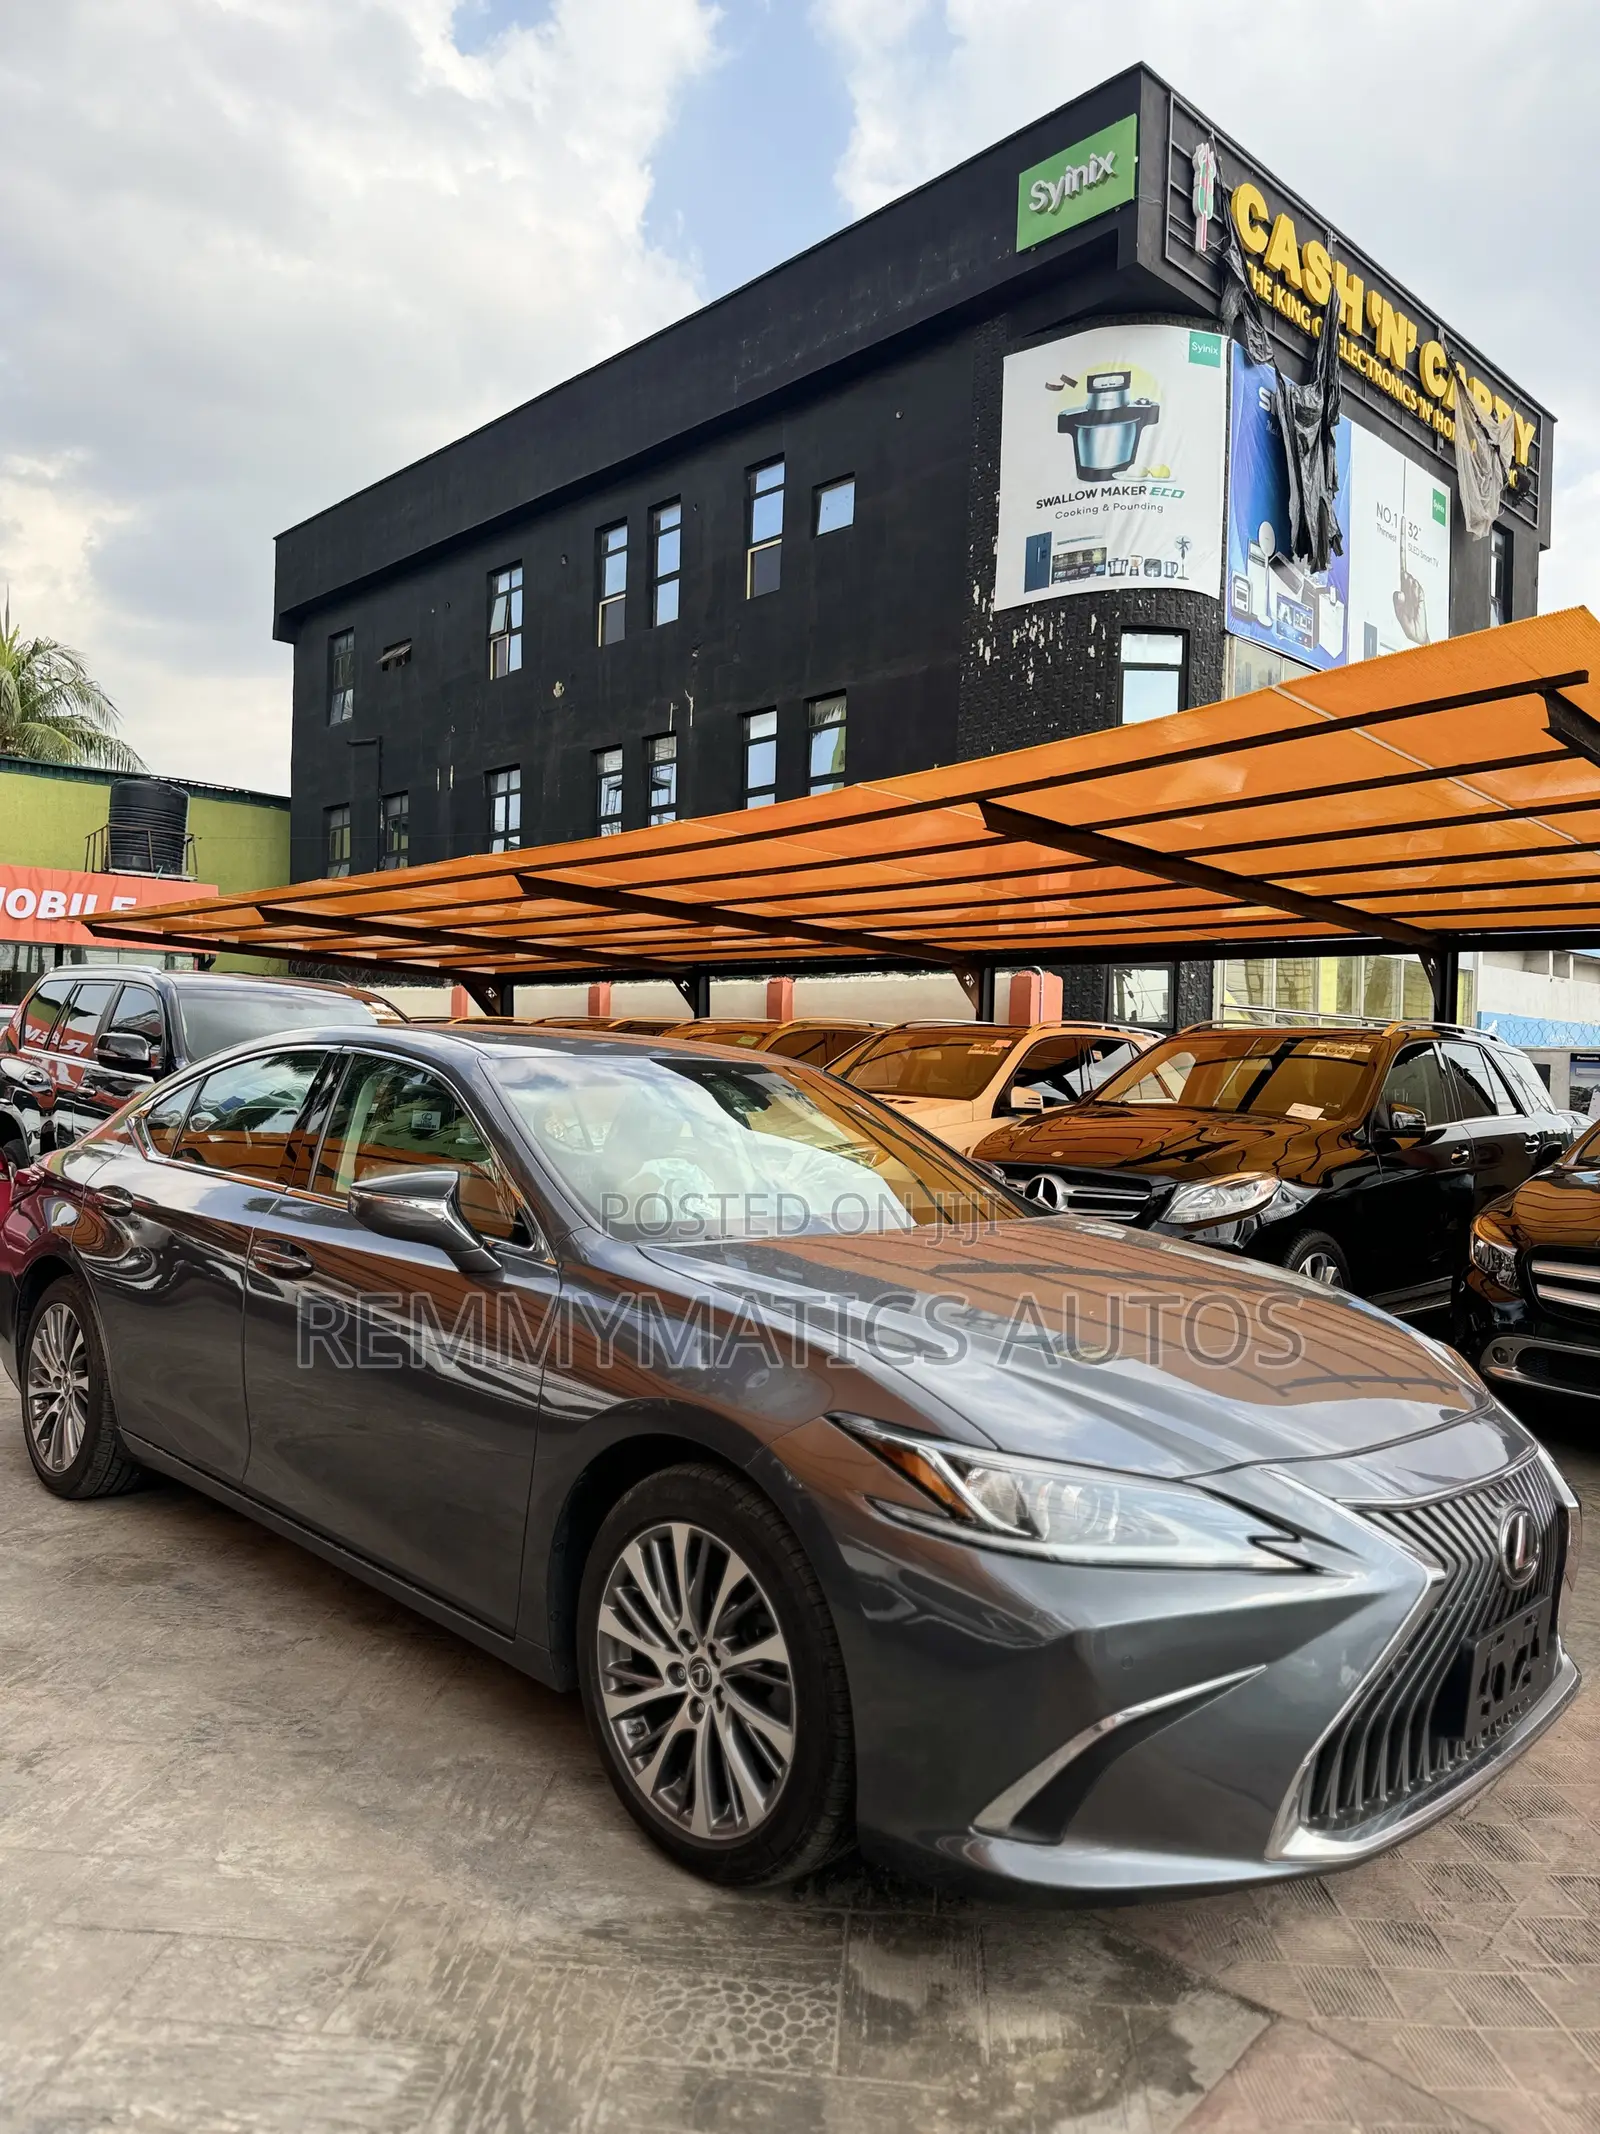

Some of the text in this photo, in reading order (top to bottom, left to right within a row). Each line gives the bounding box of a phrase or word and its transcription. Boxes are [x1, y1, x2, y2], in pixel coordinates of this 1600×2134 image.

[1028, 150, 1118, 213] Syinix
[1231, 183, 1364, 336] CASH
[1191, 341, 1220, 356] Syinix
[1273, 285, 1311, 332] KING
[1339, 332, 1417, 411] ELECTRONICS
[1036, 485, 1186, 510] SWALLOW MAKER ECO
[1055, 502, 1164, 520] Cooking & Pounding
